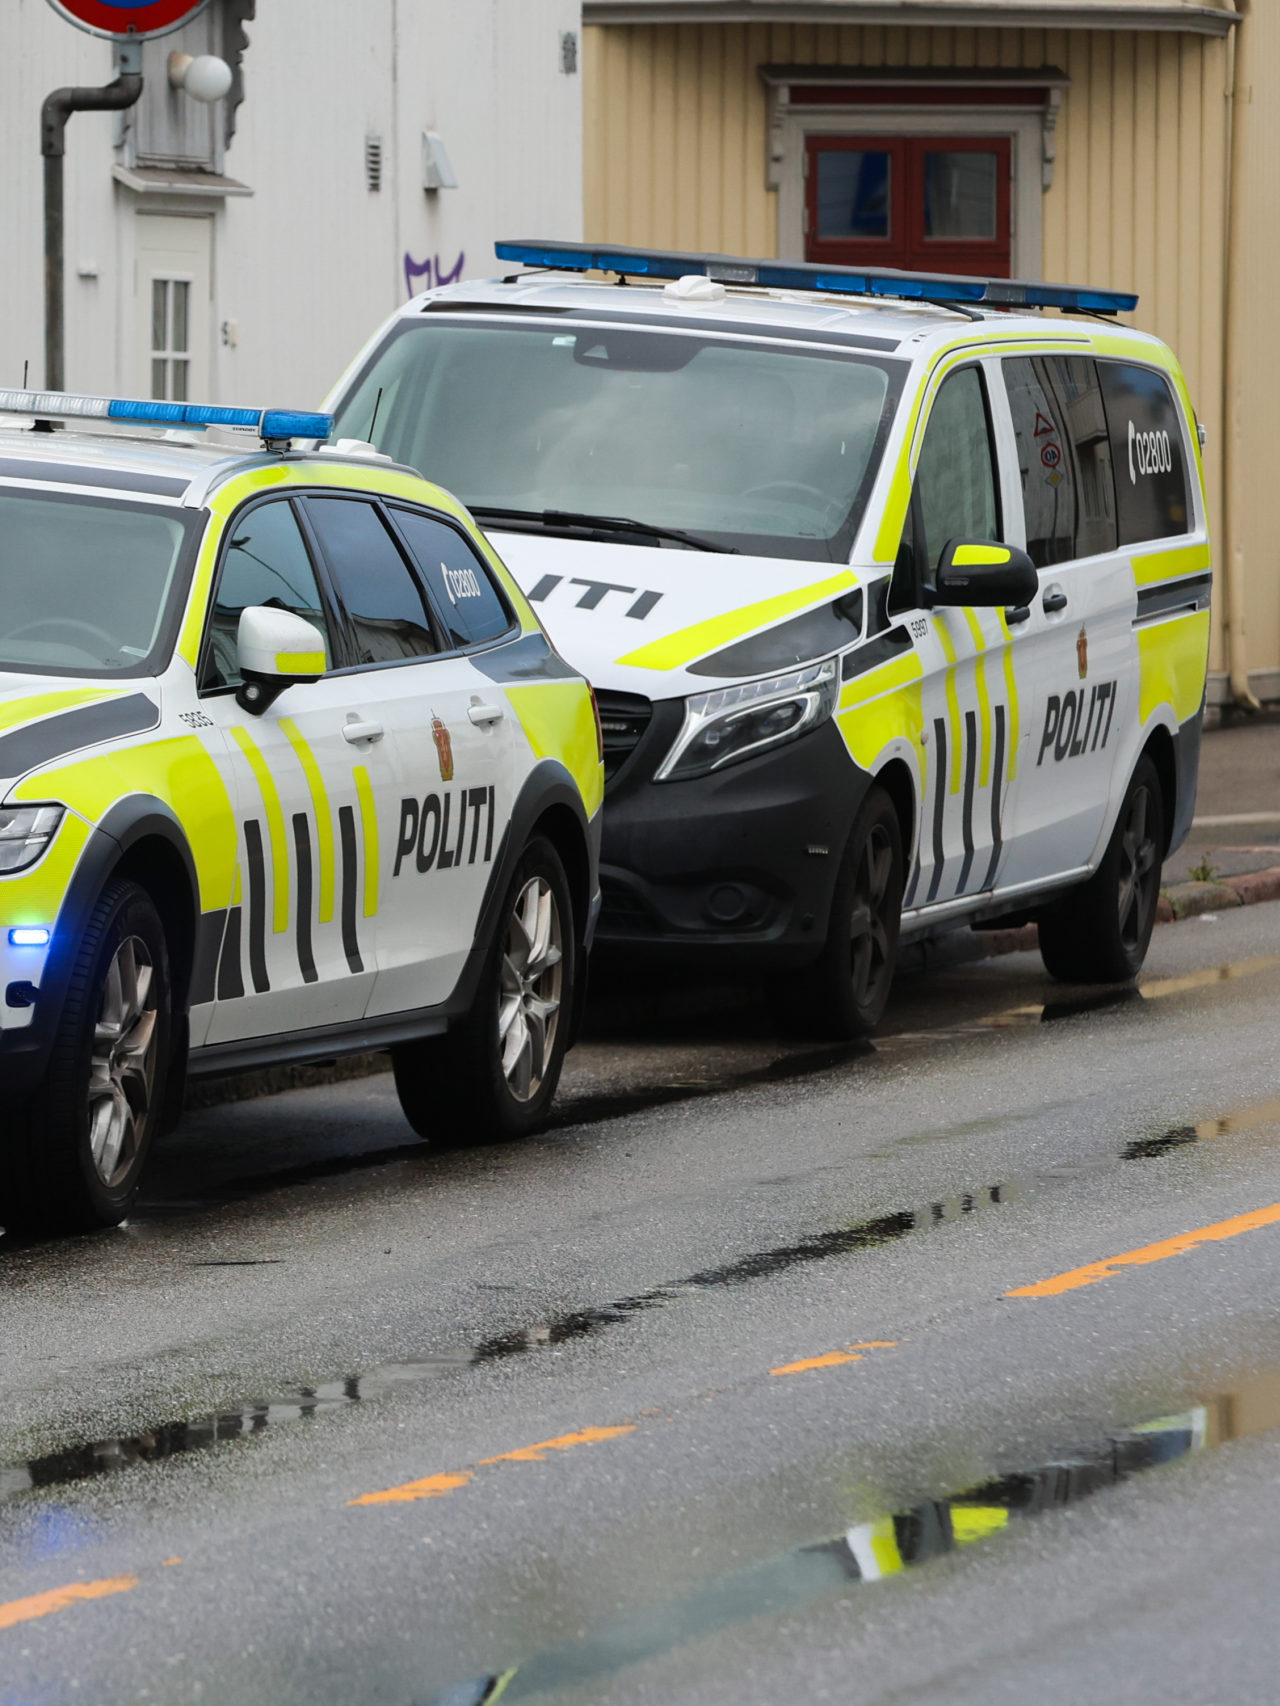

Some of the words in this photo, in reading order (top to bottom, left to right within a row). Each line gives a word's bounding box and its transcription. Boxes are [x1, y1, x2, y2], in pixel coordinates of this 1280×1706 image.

[1135, 430, 1172, 476] 02800
[447, 569, 482, 599] 02800
[526, 573, 665, 620] ITI
[910, 618, 929, 639] 5997
[178, 711, 214, 728] 5835
[1036, 680, 1118, 767] POLITI
[393, 785, 496, 877] POLITI
